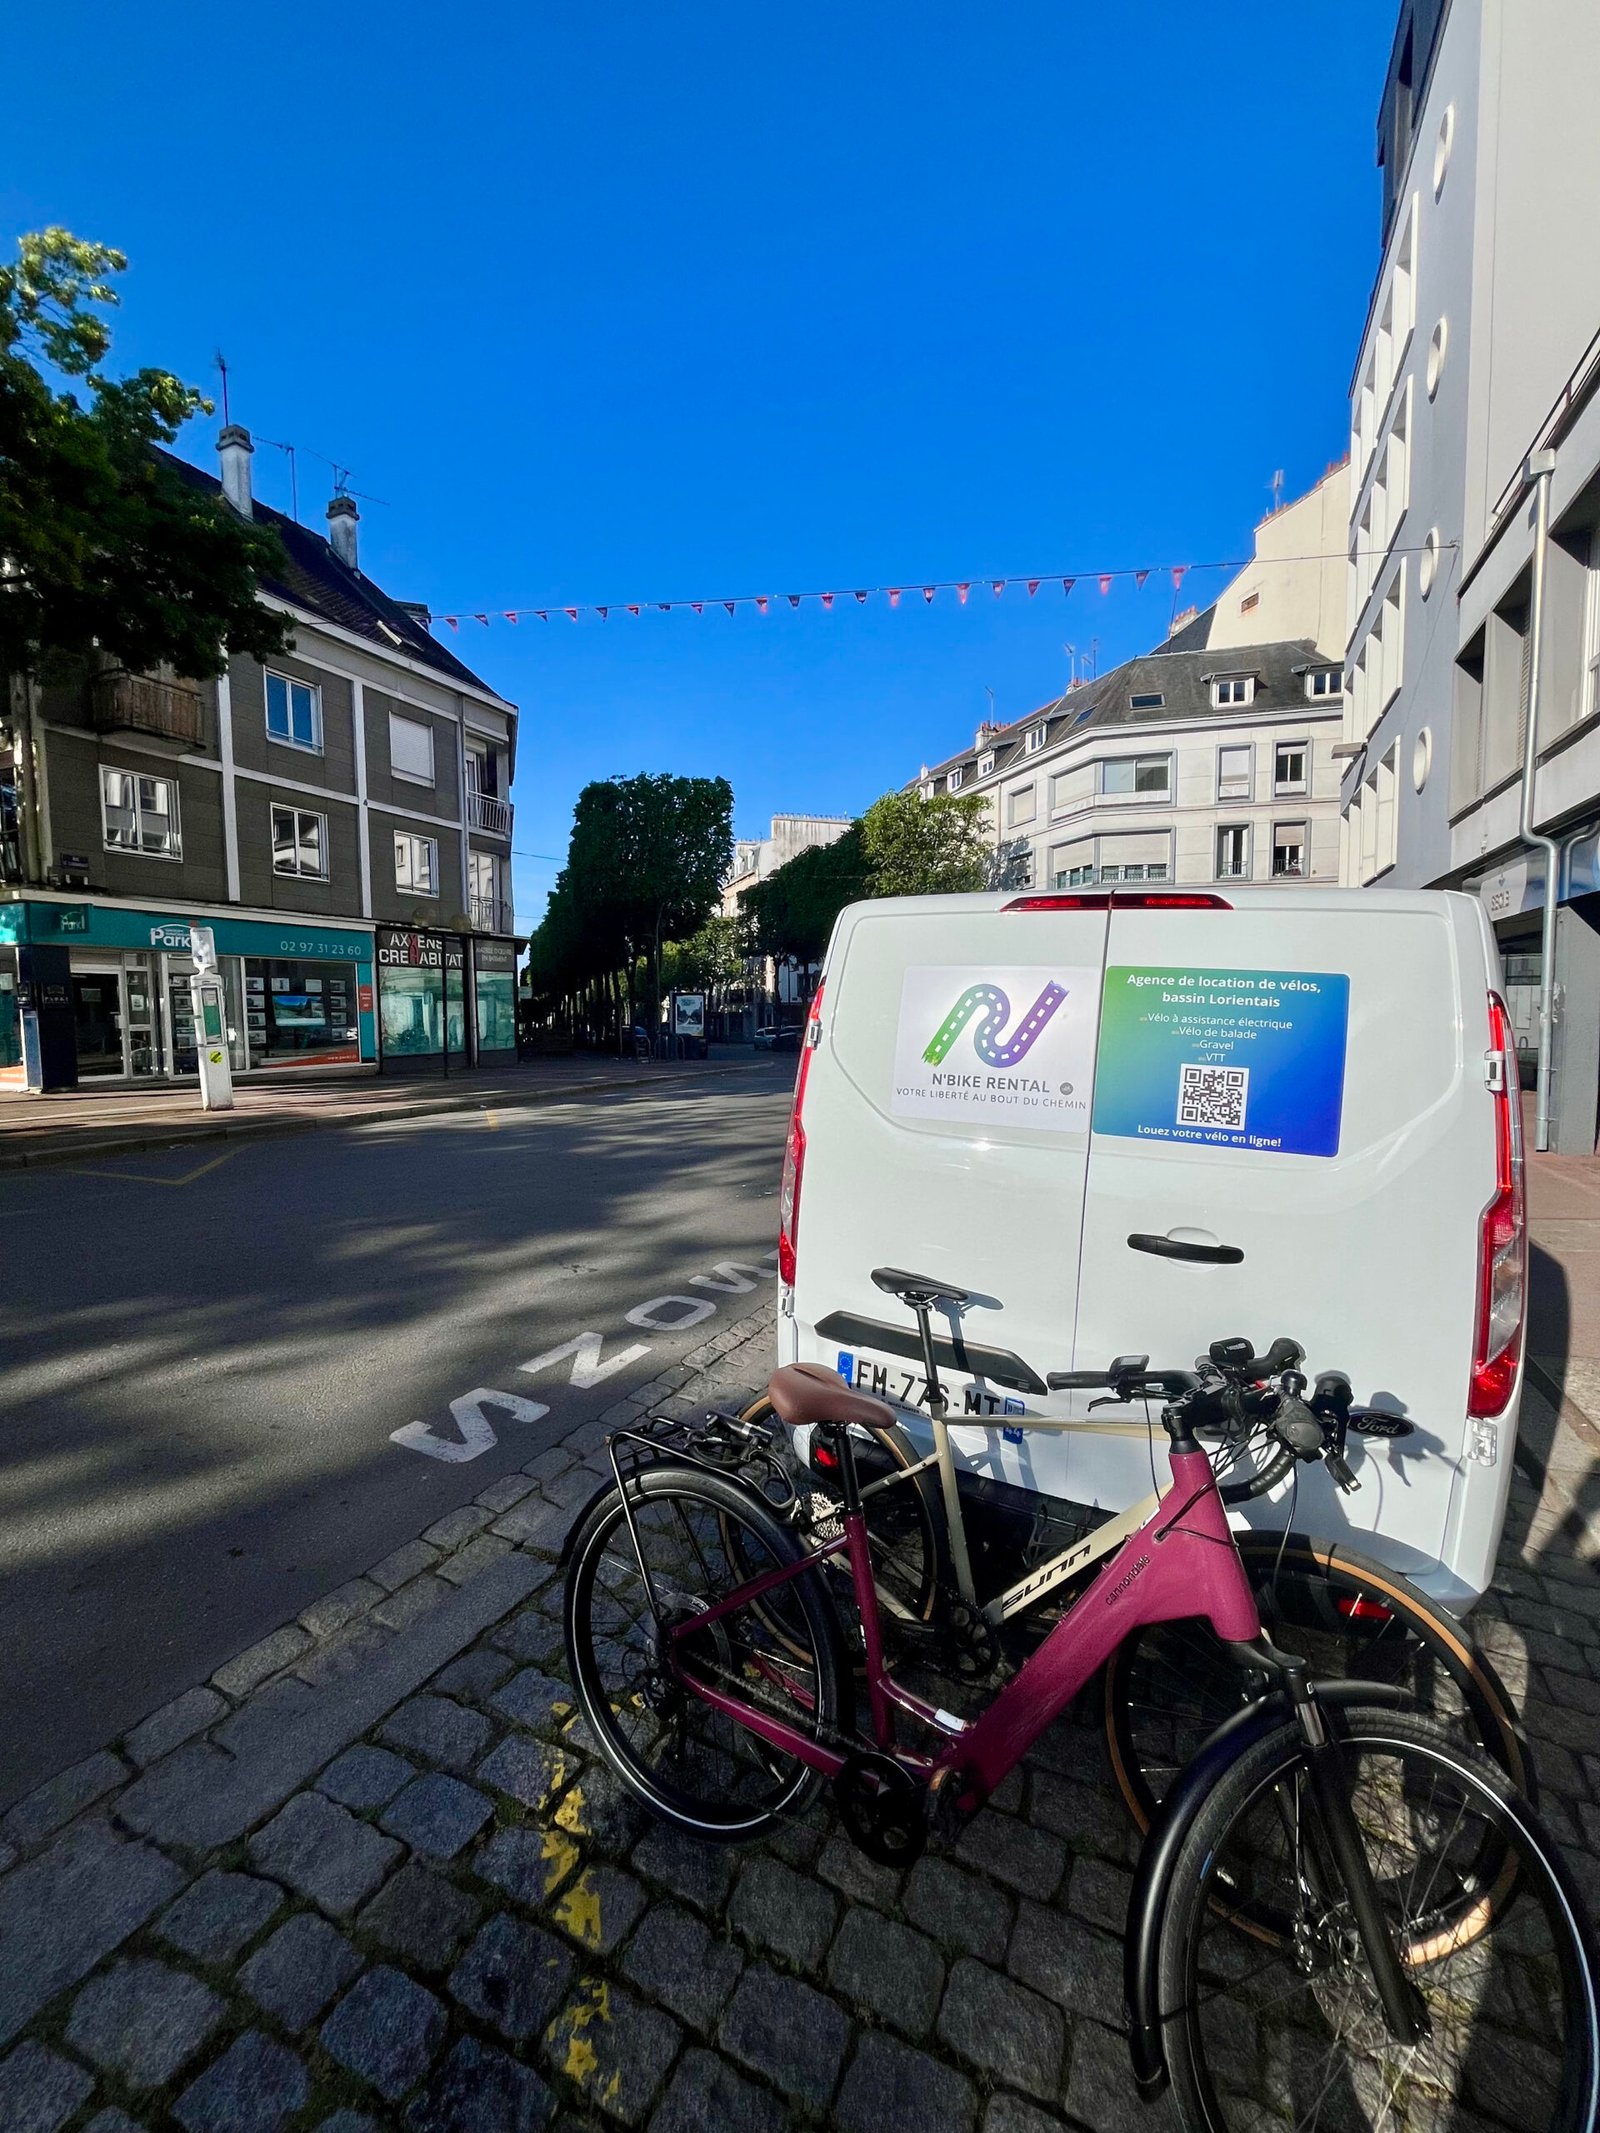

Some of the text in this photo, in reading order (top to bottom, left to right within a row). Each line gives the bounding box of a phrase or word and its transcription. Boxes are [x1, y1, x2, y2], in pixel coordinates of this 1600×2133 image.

[150, 927, 194, 948] Park
[280, 940, 361, 956] 02 97 31 23 60
[1127, 974, 1321, 993] Agence de location de vélos,
[1162, 991, 1281, 1007] bassin Lorientais
[1147, 1013, 1293, 1030] Vélo à assistance électrique
[1178, 1026, 1257, 1039] Vélo de balade
[1199, 1039, 1234, 1050] Gravel
[1205, 1053, 1226, 1062] VTT
[932, 1073, 1050, 1093] N'BIKE RENTAL
[896, 1088, 1087, 1110] VOTRE LIBERTÉ AU BOUT DU CHEMIN
[1137, 1124, 1282, 1147] Louez votre vélo en ligne!
[1357, 1416, 1399, 1434] Ford
[1105, 1554, 1150, 1606] cannondale
